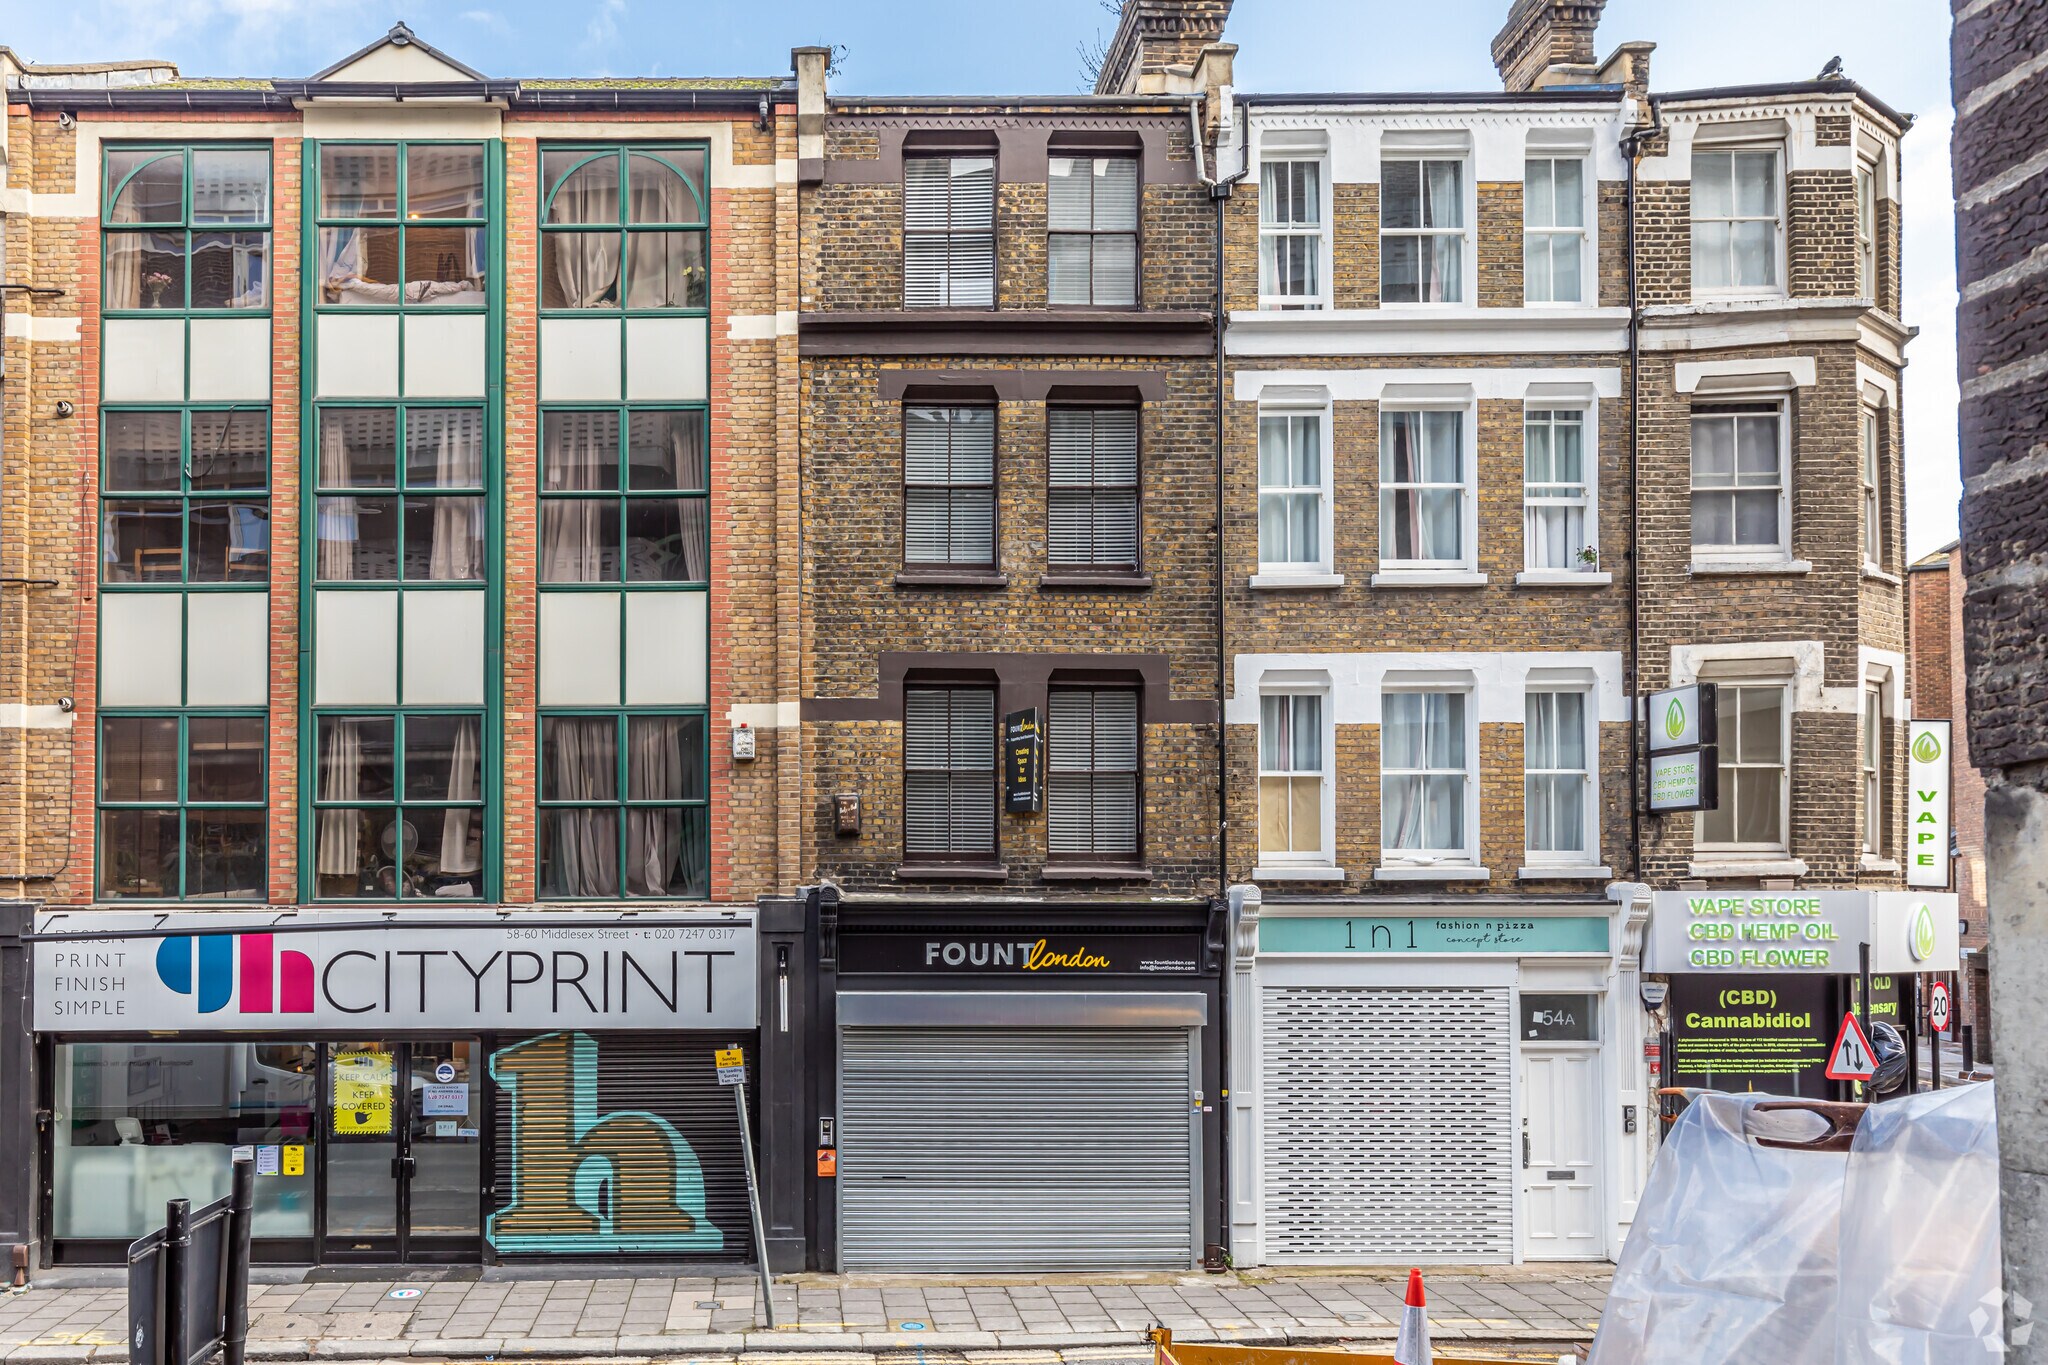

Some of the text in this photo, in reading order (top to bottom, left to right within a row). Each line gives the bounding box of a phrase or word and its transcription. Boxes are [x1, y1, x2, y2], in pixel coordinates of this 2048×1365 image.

[1655, 764, 1695, 777] VAPE STORE
[1653, 776, 1697, 789] CBD HEMP OIL
[1653, 789, 1694, 801] CBD FLOWER
[1916, 790, 1938, 866] VAPE
[1688, 898, 1821, 916] VAPE STORE
[1436, 920, 1534, 931] fashion n pizza
[1689, 923, 1840, 940] CBD HEMP OIL
[506, 928, 538, 940] 58-60
[541, 928, 594, 940] Middlesex
[598, 928, 630, 940] Street
[654, 928, 675, 940] 020
[678, 928, 705, 940] 7247
[709, 928, 735, 940] 0317
[1446, 932, 1524, 948] concept store
[55, 953, 126, 968] PRINT
[925, 938, 1110, 971] FOUNT london
[1690, 949, 1830, 966] CBD FLOWER
[55, 976, 126, 992] FINISH
[322, 949, 736, 1014] CITYPRINT
[1873, 976, 1892, 990] OLD
[1719, 989, 1777, 1009] (CBD)
[1933, 996, 1948, 1017] 20
[54, 1000, 126, 1015] SIMPLE
[1543, 1009, 1576, 1026] 54A
[1685, 1012, 1811, 1029] Cannabidiol
[339, 1073, 389, 1081] KEEP CALM
[352, 1091, 375, 1099] KEEP
[341, 1102, 386, 1111] COVERED
